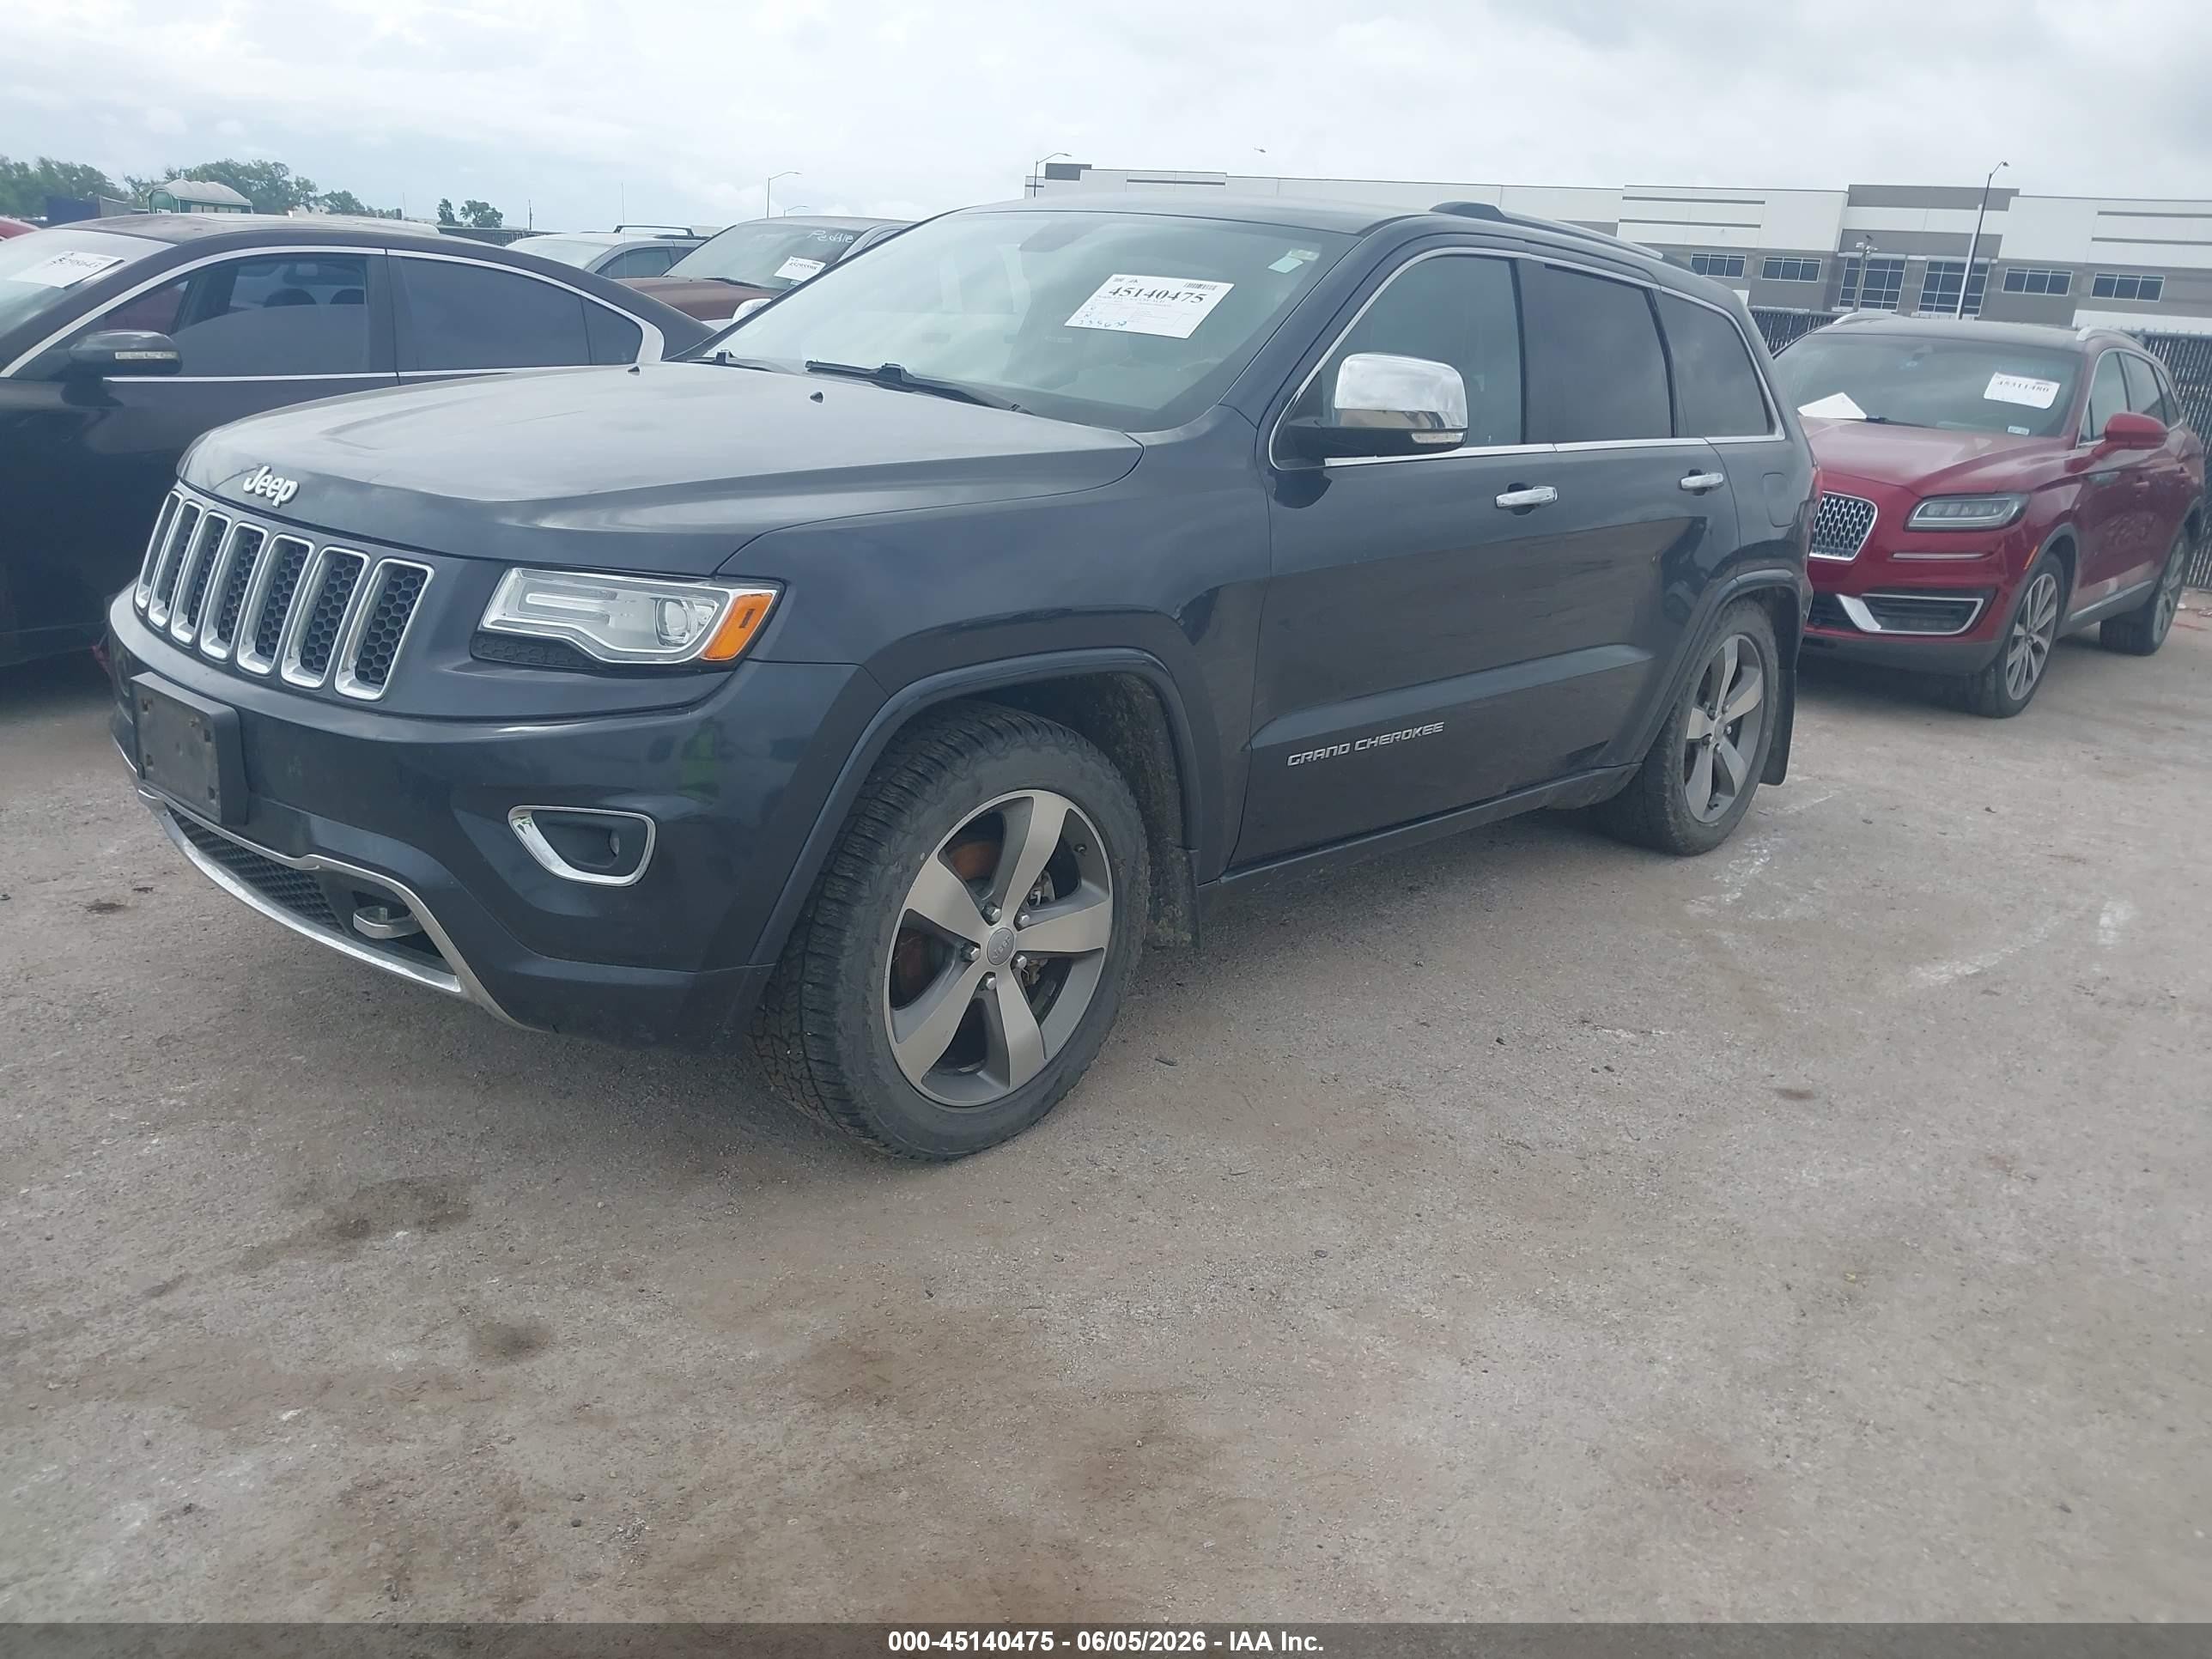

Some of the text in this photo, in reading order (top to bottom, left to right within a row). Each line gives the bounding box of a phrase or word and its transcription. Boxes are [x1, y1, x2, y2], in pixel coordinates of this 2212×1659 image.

[1108, 286, 1208, 304] 45140475
[243, 465, 299, 508] Jeep
[1287, 721, 1444, 767] GRAND CHEROKEE
